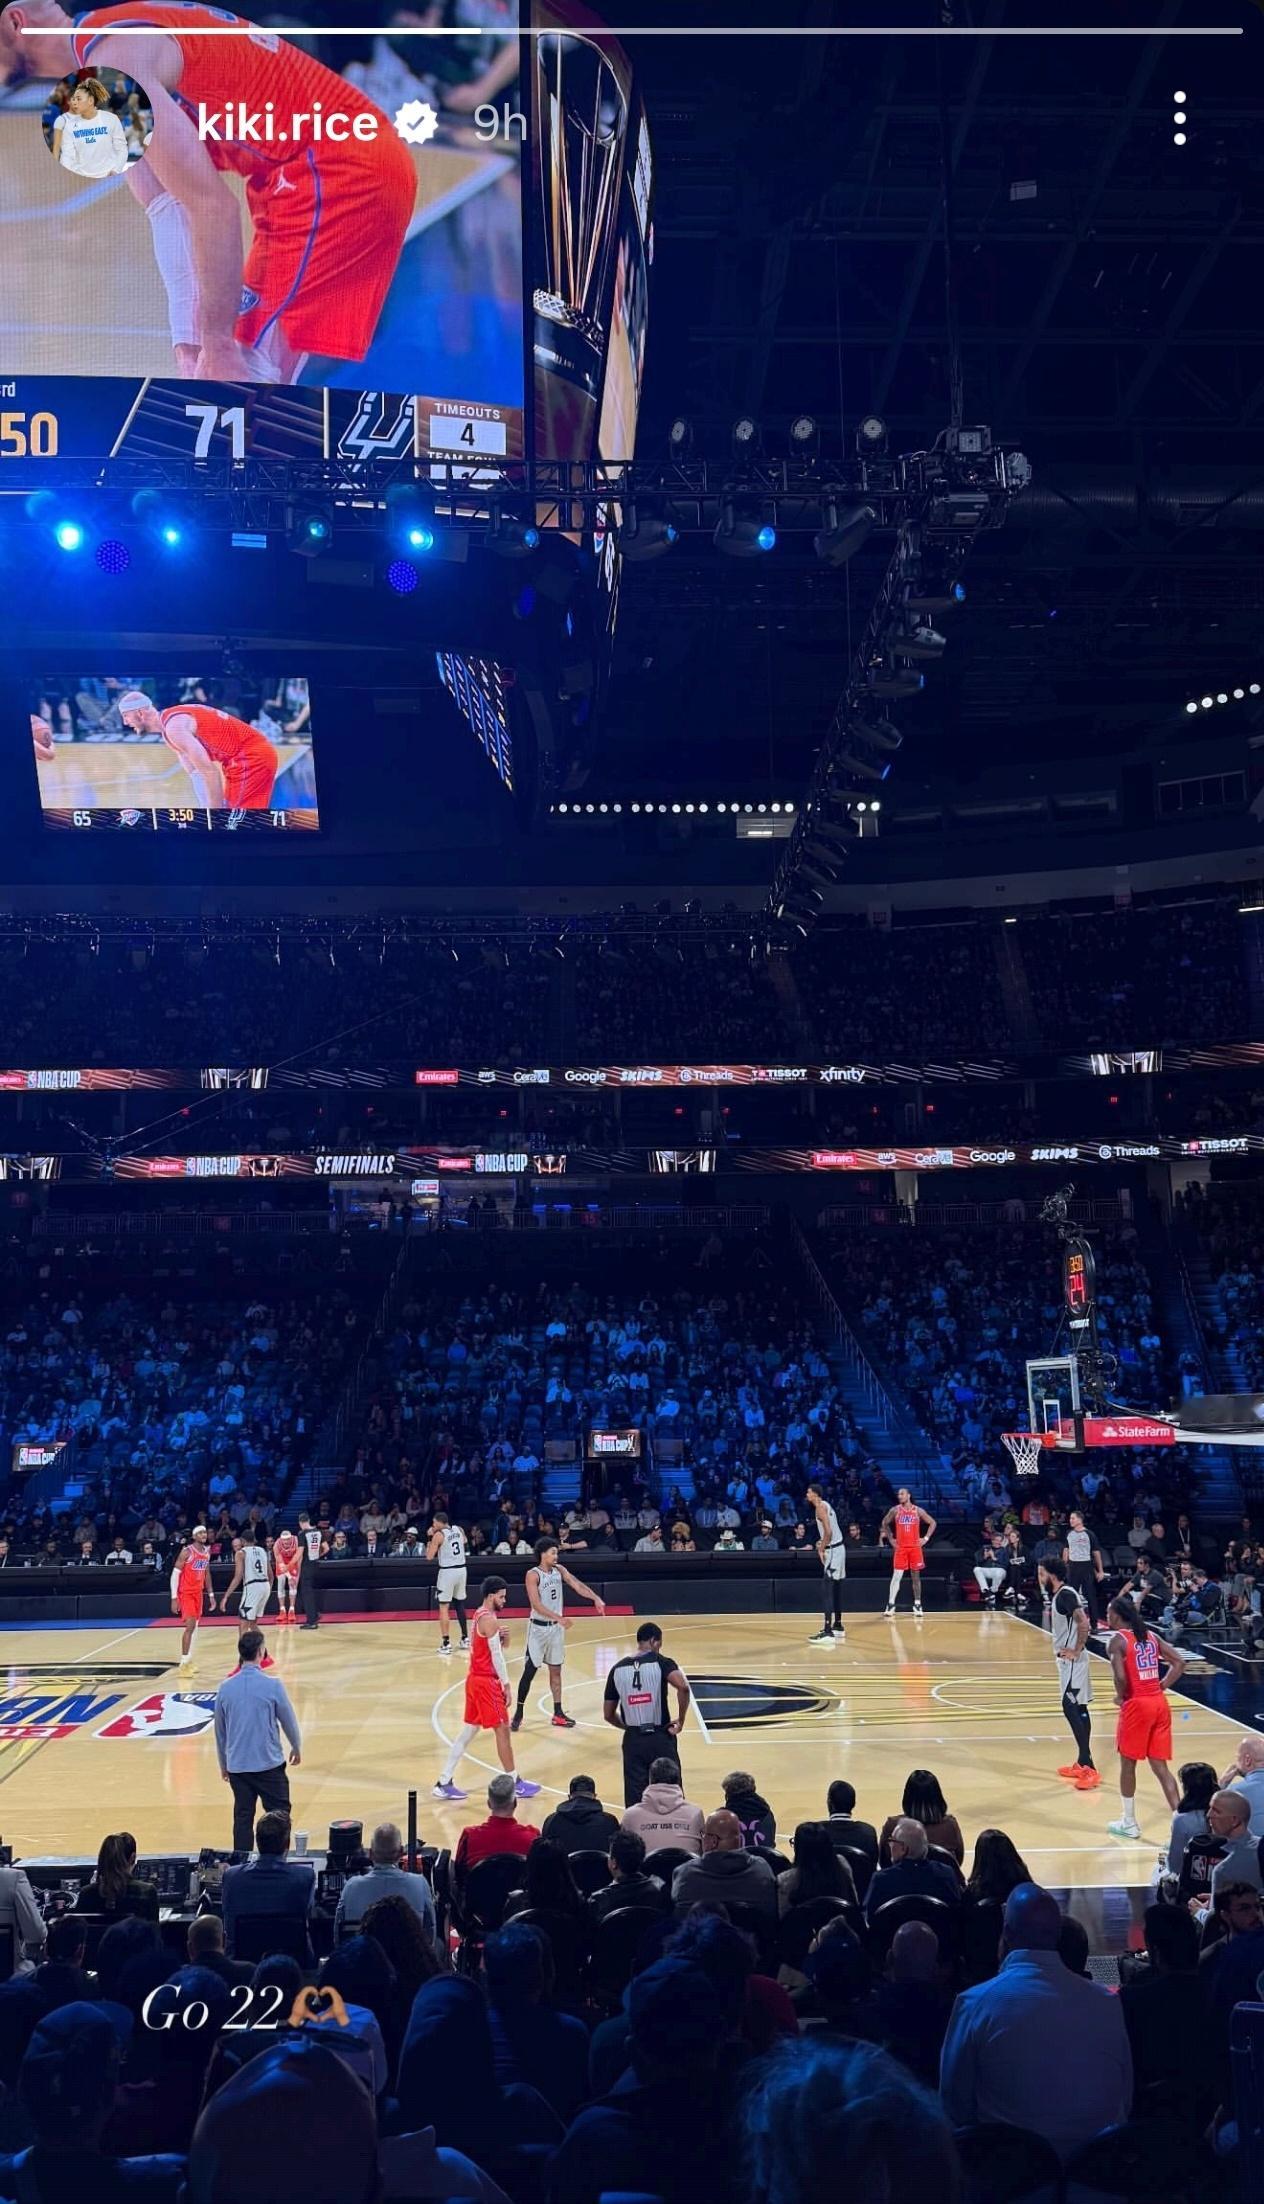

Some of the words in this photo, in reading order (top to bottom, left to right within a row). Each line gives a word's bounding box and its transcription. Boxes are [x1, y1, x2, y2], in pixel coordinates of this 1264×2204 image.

[0, 382, 16, 398] rd
[434, 403, 501, 420] TIMEOUTS
[186, 404, 245, 467] 71
[460, 422, 475, 446] 4
[73, 810, 92, 827] 65
[169, 809, 194, 822] 3:50
[270, 810, 286, 826] 71
[37, 1070, 59, 1089] NBA
[60, 1070, 81, 1089] CUP
[419, 1071, 456, 1081] Emirates
[478, 1071, 495, 1080] aws
[564, 1071, 606, 1084] Google
[620, 1071, 662, 1082] SKIMS
[694, 1070, 734, 1080] Threads
[820, 1066, 866, 1083] xfinity
[816, 1154, 854, 1163] Emirates
[970, 1149, 1016, 1164] Google
[1030, 1147, 1078, 1160] SKIMS
[1113, 1145, 1160, 1157] Threads
[197, 1157, 219, 1176] NBA
[220, 1157, 241, 1175] CUP
[315, 1155, 395, 1175] SEMIFINALS
[484, 1154, 506, 1172] NBA
[507, 1154, 528, 1172] CUP
[1069, 1272, 1085, 1305] 24
[451, 1541, 460, 1555] 3
[254, 1559, 263, 1573] 4
[551, 1589, 557, 1600] 2
[1134, 1640, 1158, 1669] 22
[632, 1670, 642, 1691] 4
